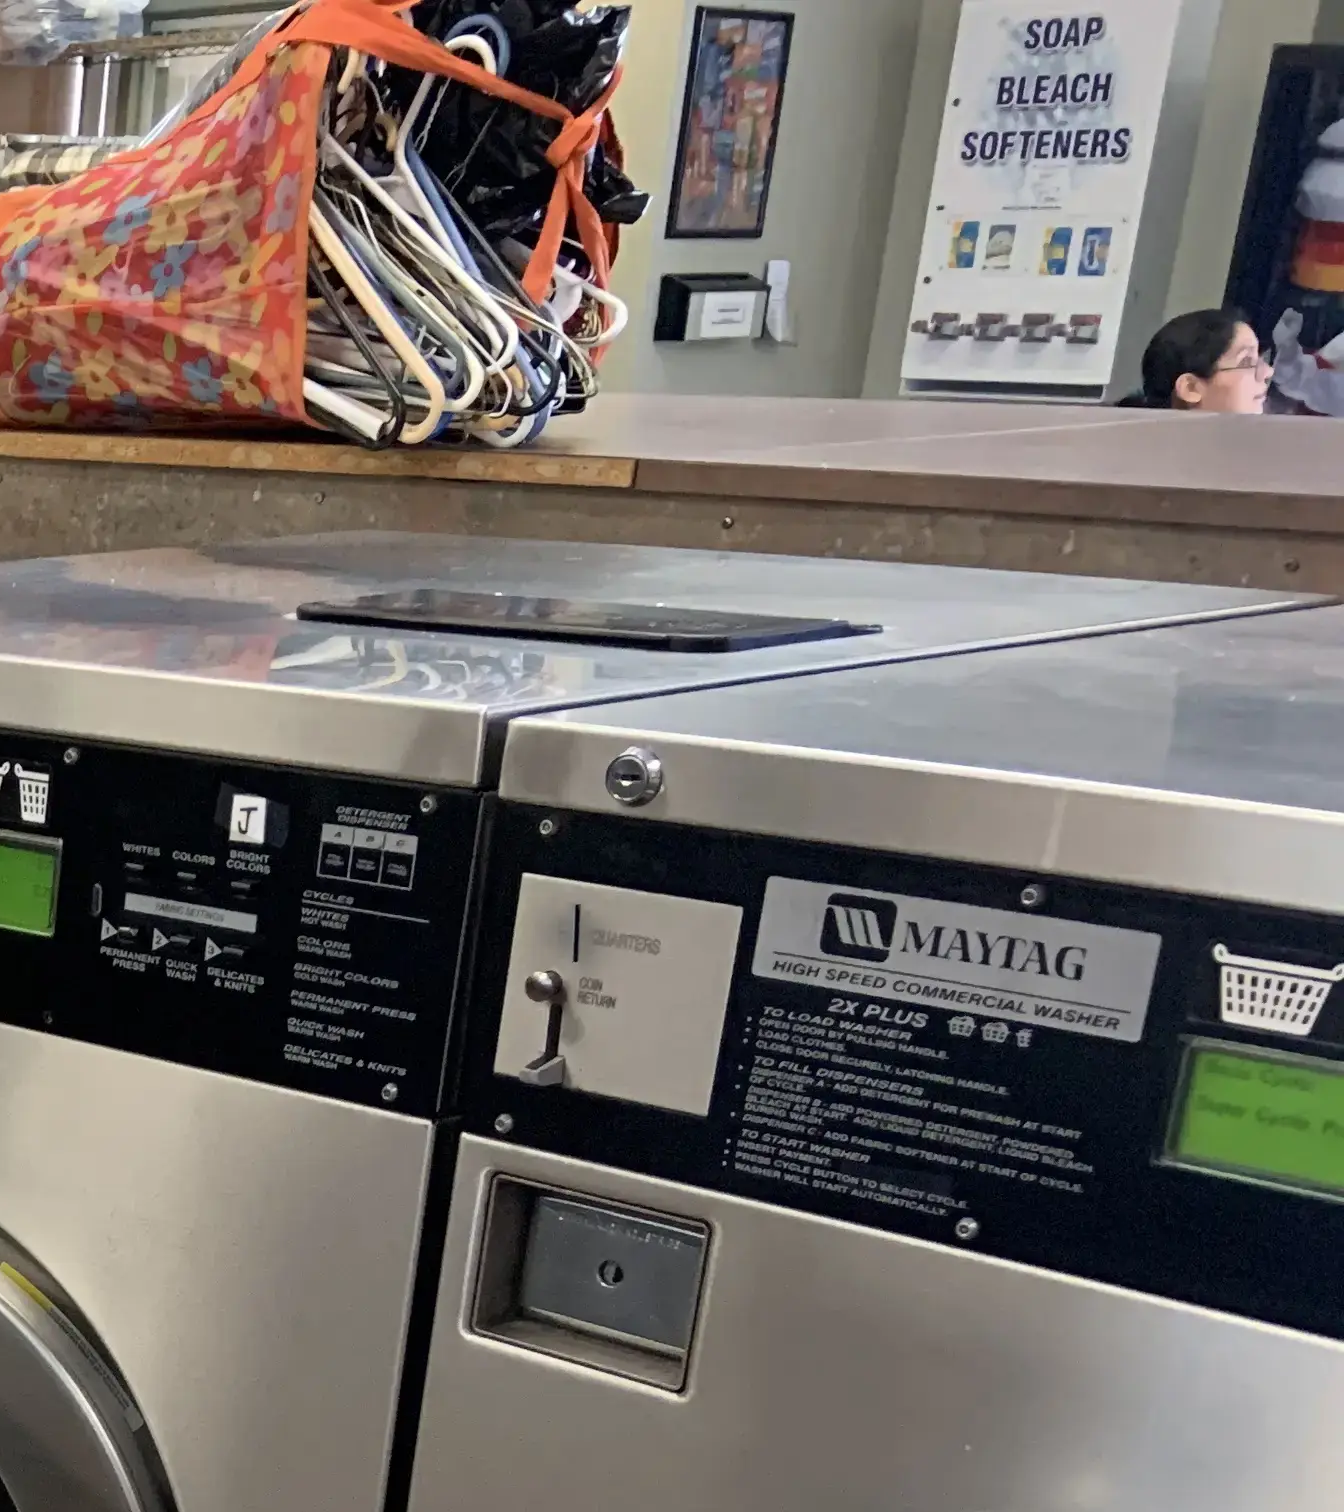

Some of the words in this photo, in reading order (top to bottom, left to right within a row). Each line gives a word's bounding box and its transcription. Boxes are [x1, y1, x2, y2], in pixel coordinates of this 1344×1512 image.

[1024, 17, 1104, 49] SOAP
[996, 72, 1113, 106] BLEACH
[961, 128, 1130, 160] SOFTENERS
[238, 806, 258, 835] J
[336, 806, 411, 822] DETERGENT
[338, 814, 408, 831] DISPENSER
[122, 842, 160, 857] WHITES
[172, 851, 216, 866] COLORS
[230, 850, 270, 864] BRIGHT
[226, 860, 271, 875] COLORS
[302, 890, 354, 905] CYCLES
[301, 907, 350, 922] WHITES
[155, 936, 162, 945] 2
[296, 935, 351, 951] COLORS
[100, 946, 161, 966] PERMANENT
[326, 950, 352, 960] WASH
[899, 920, 1088, 982] MAYTAG
[112, 958, 146, 972] PRESS
[166, 959, 198, 972] QUICK
[166, 968, 196, 982] WASH
[207, 966, 264, 986] DELICATES
[294, 962, 342, 978] BRIGHT
[344, 972, 399, 989] COLORS
[579, 976, 603, 991] COIN
[214, 978, 222, 988] &
[224, 980, 256, 994] KNITS
[772, 959, 819, 979] HIGH
[825, 967, 887, 990] SPEED
[892, 979, 1027, 1014] COMMERCIAL
[1033, 1004, 1121, 1031] WASHER
[290, 990, 370, 1012] PERMANENT
[372, 1006, 416, 1021] PRESS
[577, 992, 616, 1010] RETURN
[828, 998, 860, 1016] 2X
[863, 1004, 929, 1028] PLUS
[287, 1017, 325, 1030] QUICK
[328, 1025, 365, 1039] WASH
[763, 1006, 785, 1017] TO
[788, 1012, 834, 1026] LOAD
[839, 1020, 912, 1041] WASHER
[758, 1029, 790, 1042] LOAD
[759, 1018, 790, 1030] OPEN
[792, 1023, 826, 1037] DOOR
[828, 1030, 844, 1040] BY
[846, 1033, 896, 1050] PULLING
[284, 1044, 353, 1065] DELICATES
[356, 1060, 364, 1068] &
[368, 1062, 408, 1076] KNITS
[756, 1040, 794, 1054] CLOSE
[796, 1048, 830, 1060] DOOR
[895, 1066, 954, 1085] LATCHING
[749, 1075, 764, 1084] OF
[754, 1055, 775, 1067] TO
[778, 1060, 813, 1074] FILL
[816, 1068, 924, 1096] DISPENSERS
[816, 1080, 824, 1088] A
[833, 1083, 858, 1095] ADD
[860, 1088, 932, 1108] DETERGENT
[933, 1102, 958, 1114] FOR
[1023, 1120, 1040, 1130] AT
[1041, 1124, 1082, 1139] START
[829, 1103, 854, 1114] ADD
[852, 1116, 878, 1128] ADD
[736, 1140, 776, 1155] INSERT
[742, 1128, 759, 1140] TO
[762, 1133, 808, 1150] START
[810, 1143, 871, 1164] WASHER
[824, 1131, 849, 1142] ADD
[960, 1160, 976, 1170] AT
[978, 1163, 1018, 1178] START
[1020, 1172, 1038, 1182] OF
[734, 1162, 781, 1180] WASHER
[783, 1173, 809, 1186] WILL
[812, 1180, 848, 1194] START
[735, 1151, 772, 1166] PRESS
[773, 1159, 811, 1174] CYCLE
[812, 1168, 860, 1186] BUTTON
[861, 1178, 878, 1188] TO
[879, 1183, 926, 1200] SELECT
